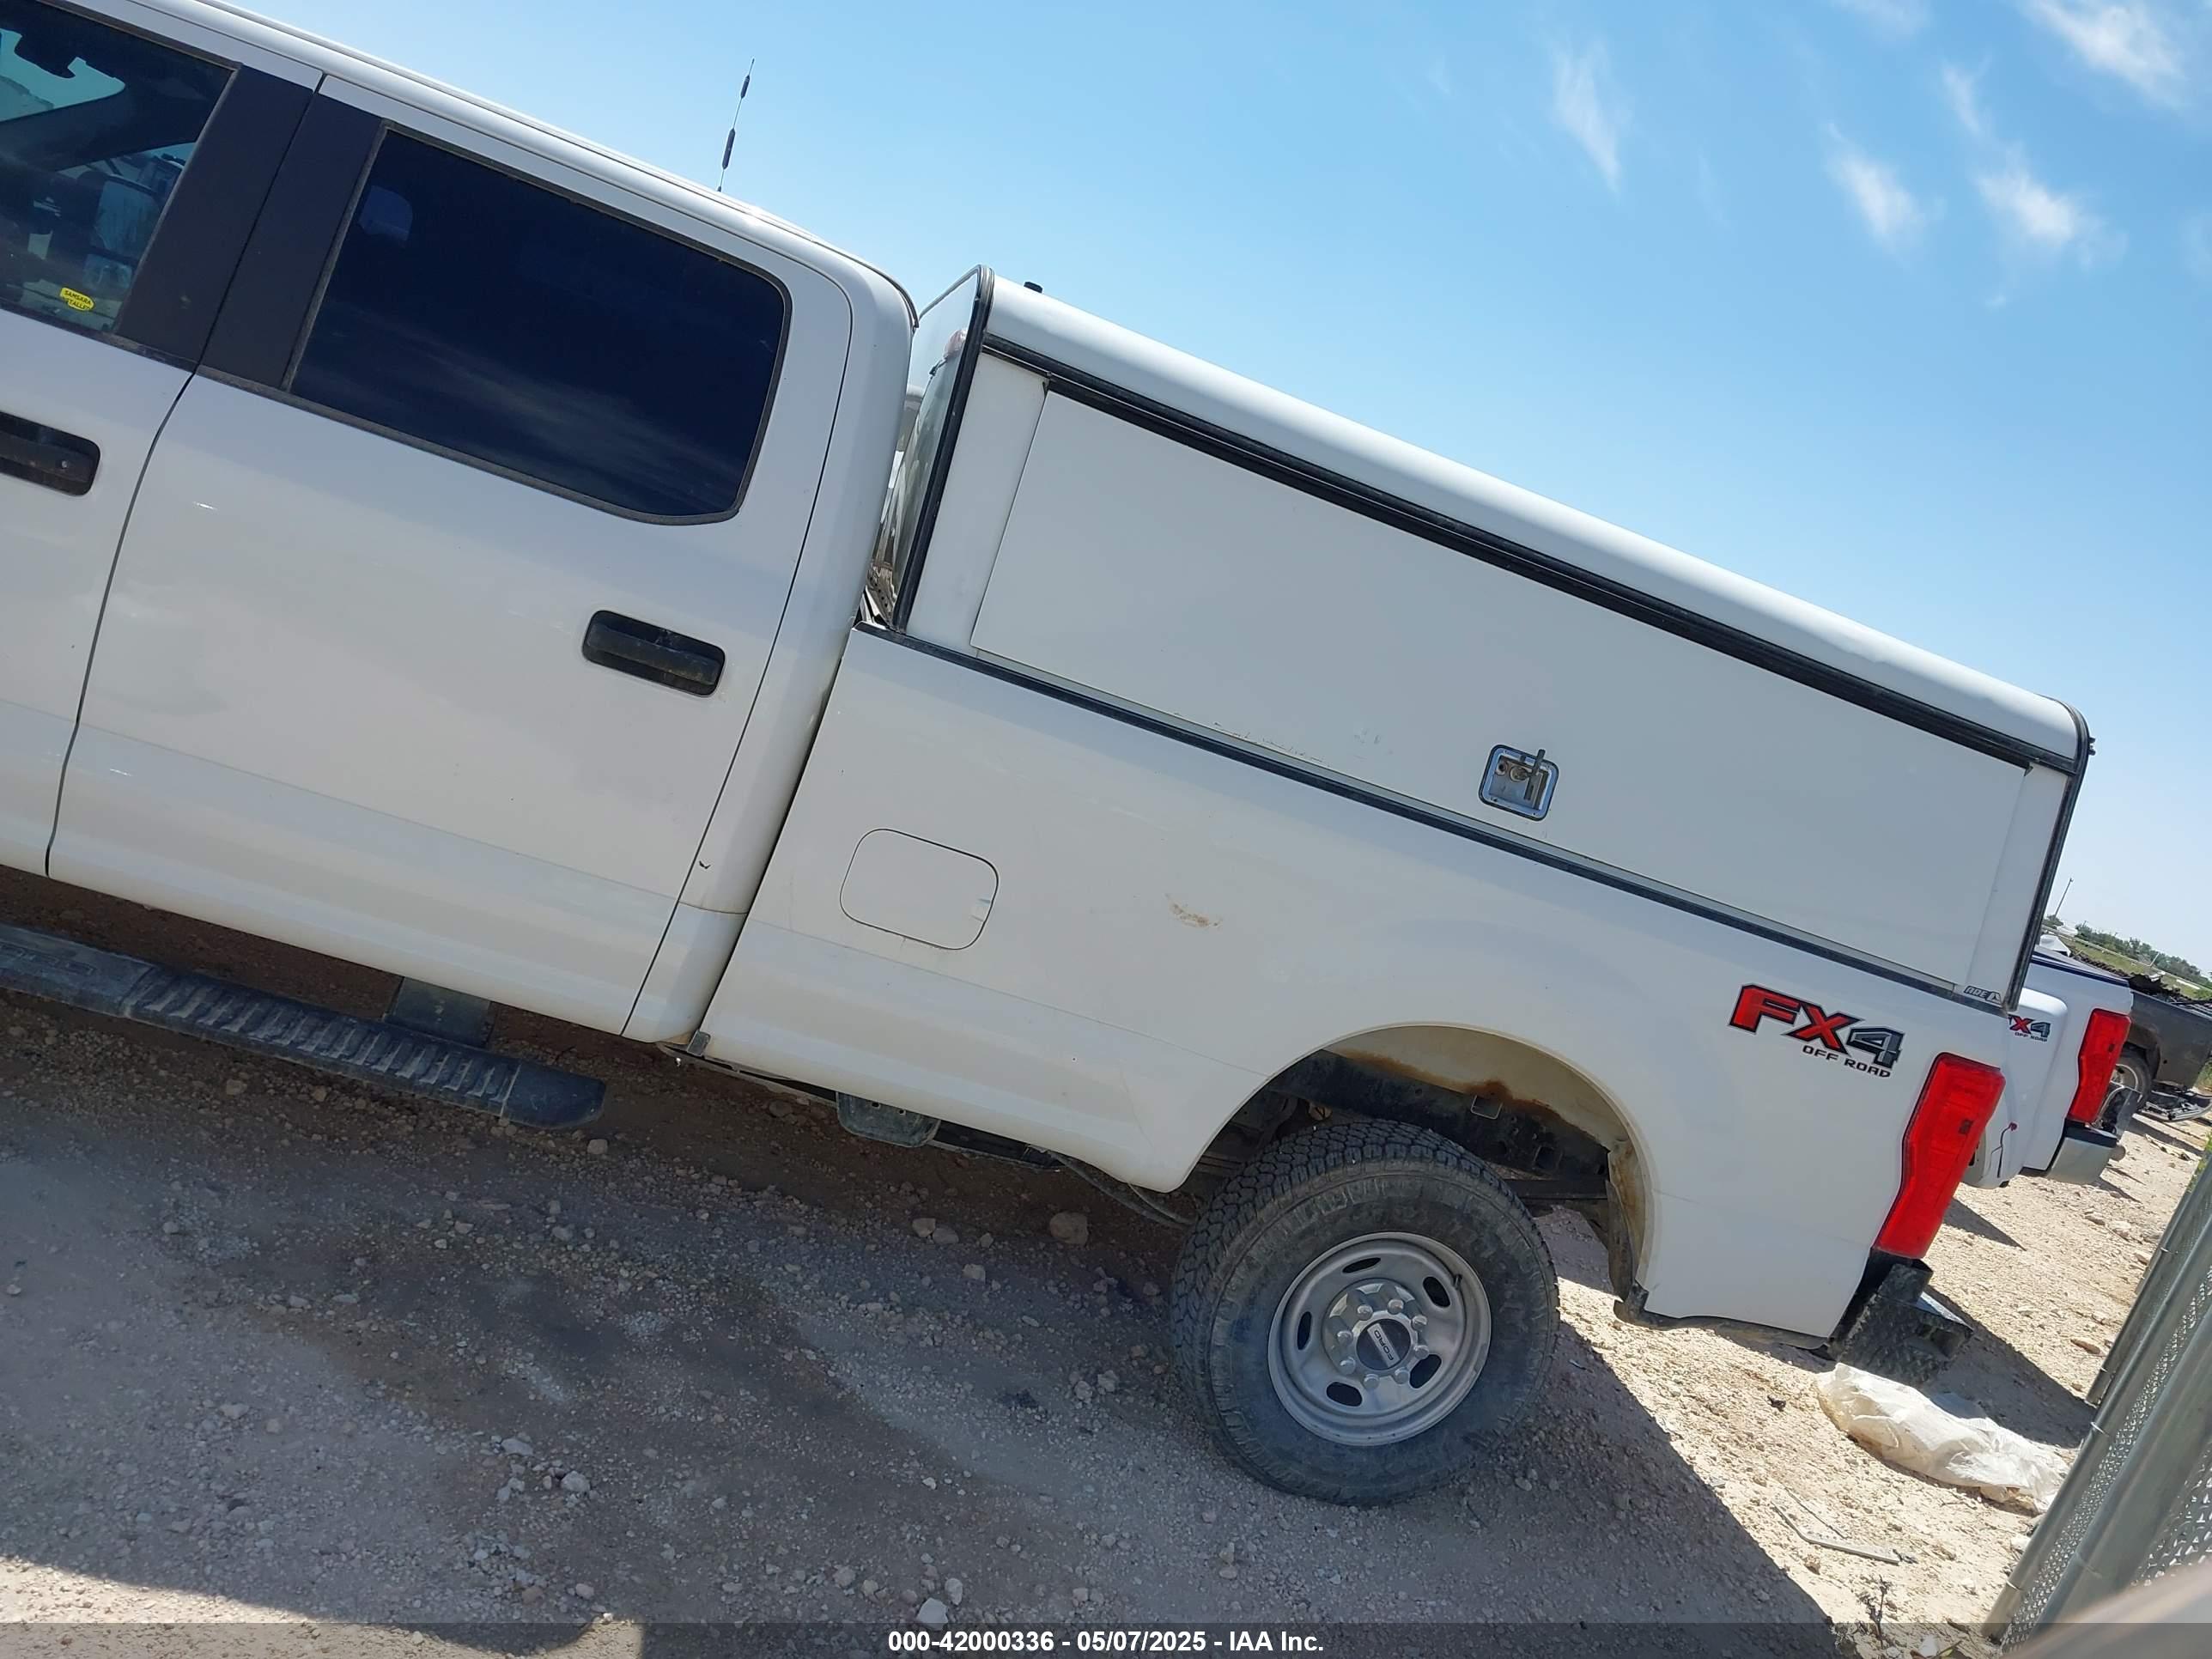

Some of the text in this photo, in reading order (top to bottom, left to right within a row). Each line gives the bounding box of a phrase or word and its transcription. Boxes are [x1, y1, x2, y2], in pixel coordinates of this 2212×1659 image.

[1728, 984, 1905, 1069] FX4
[2008, 1014, 2051, 1038] X4
[1802, 1044, 1891, 1078] OFF ROAD
[1374, 1329, 1394, 1361] FORD
